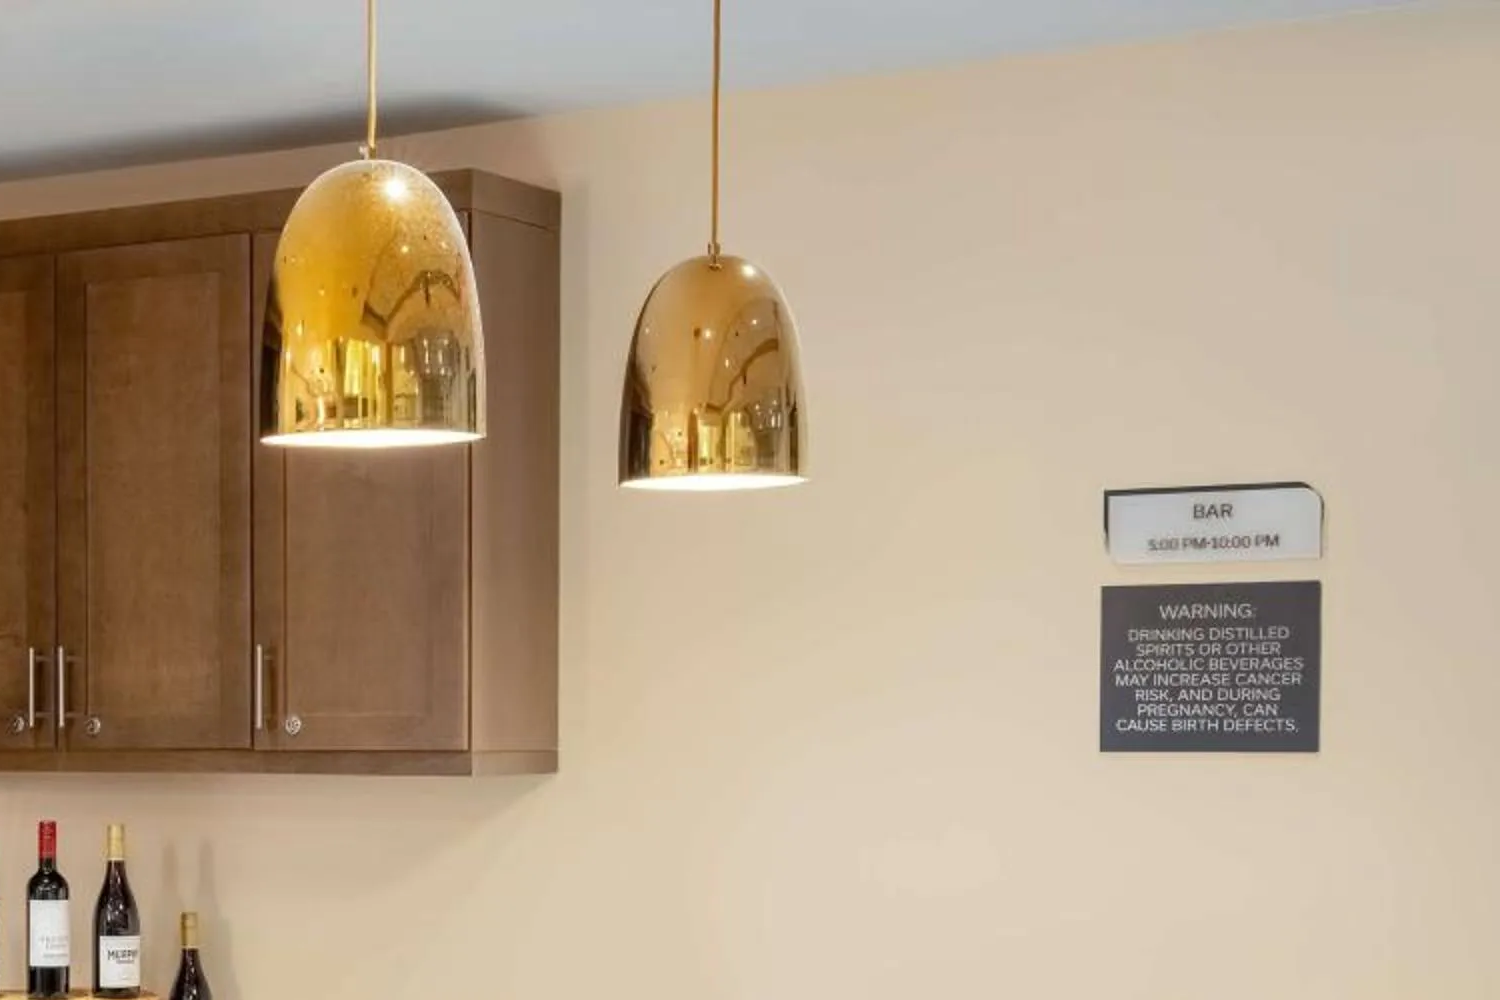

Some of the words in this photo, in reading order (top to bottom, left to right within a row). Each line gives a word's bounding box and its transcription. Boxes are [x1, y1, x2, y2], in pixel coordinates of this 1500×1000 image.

[1193, 503, 1233, 519] BAR
[1255, 533, 1280, 547] PM
[1127, 627, 1205, 642] DRINKING
[1209, 626, 1290, 640] DISTILLED
[1136, 643, 1195, 657] SPIRITS
[1199, 642, 1222, 656] OR
[1226, 641, 1282, 655] OTHER
[1113, 658, 1205, 672] ALCOHOLIC
[1209, 657, 1304, 671] BEVERAGES
[1115, 673, 1149, 687] MAY
[1153, 673, 1231, 687] INCREASE
[1235, 672, 1303, 685] CANCER
[1135, 689, 1173, 703] RISK,
[1177, 688, 1213, 701] AND
[1217, 687, 1282, 701] DURING
[1137, 703, 1238, 718] PREGNANCY,
[1243, 703, 1278, 716] CAN
[1115, 719, 1167, 732] CAUSE
[1172, 718, 1219, 731] BIRTH
